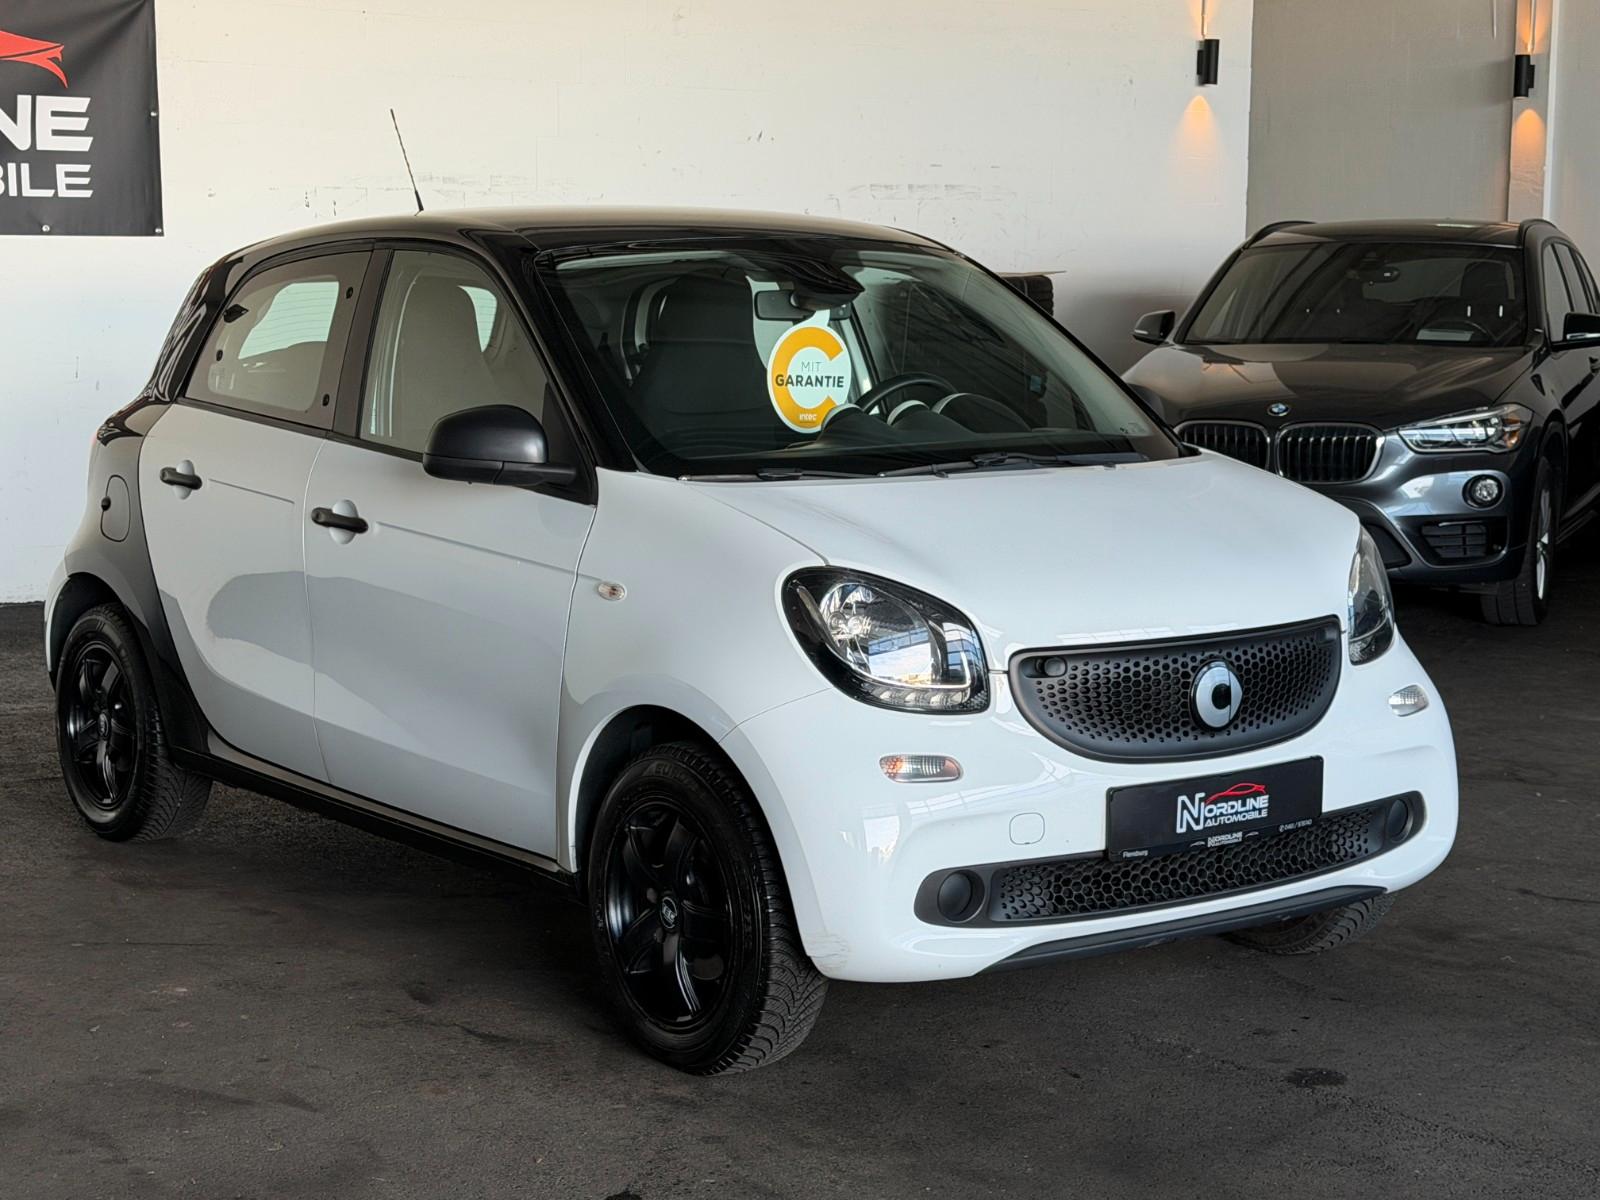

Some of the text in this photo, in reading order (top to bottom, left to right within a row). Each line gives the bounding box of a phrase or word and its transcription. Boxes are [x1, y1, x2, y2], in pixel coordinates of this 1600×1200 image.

[0, 162, 93, 198] ILE
[801, 361, 822, 373] MIT
[775, 374, 844, 388] GARANTIE
[1176, 791, 1270, 834] NORDLINE
[1204, 808, 1269, 828] AUTOMOBILE
